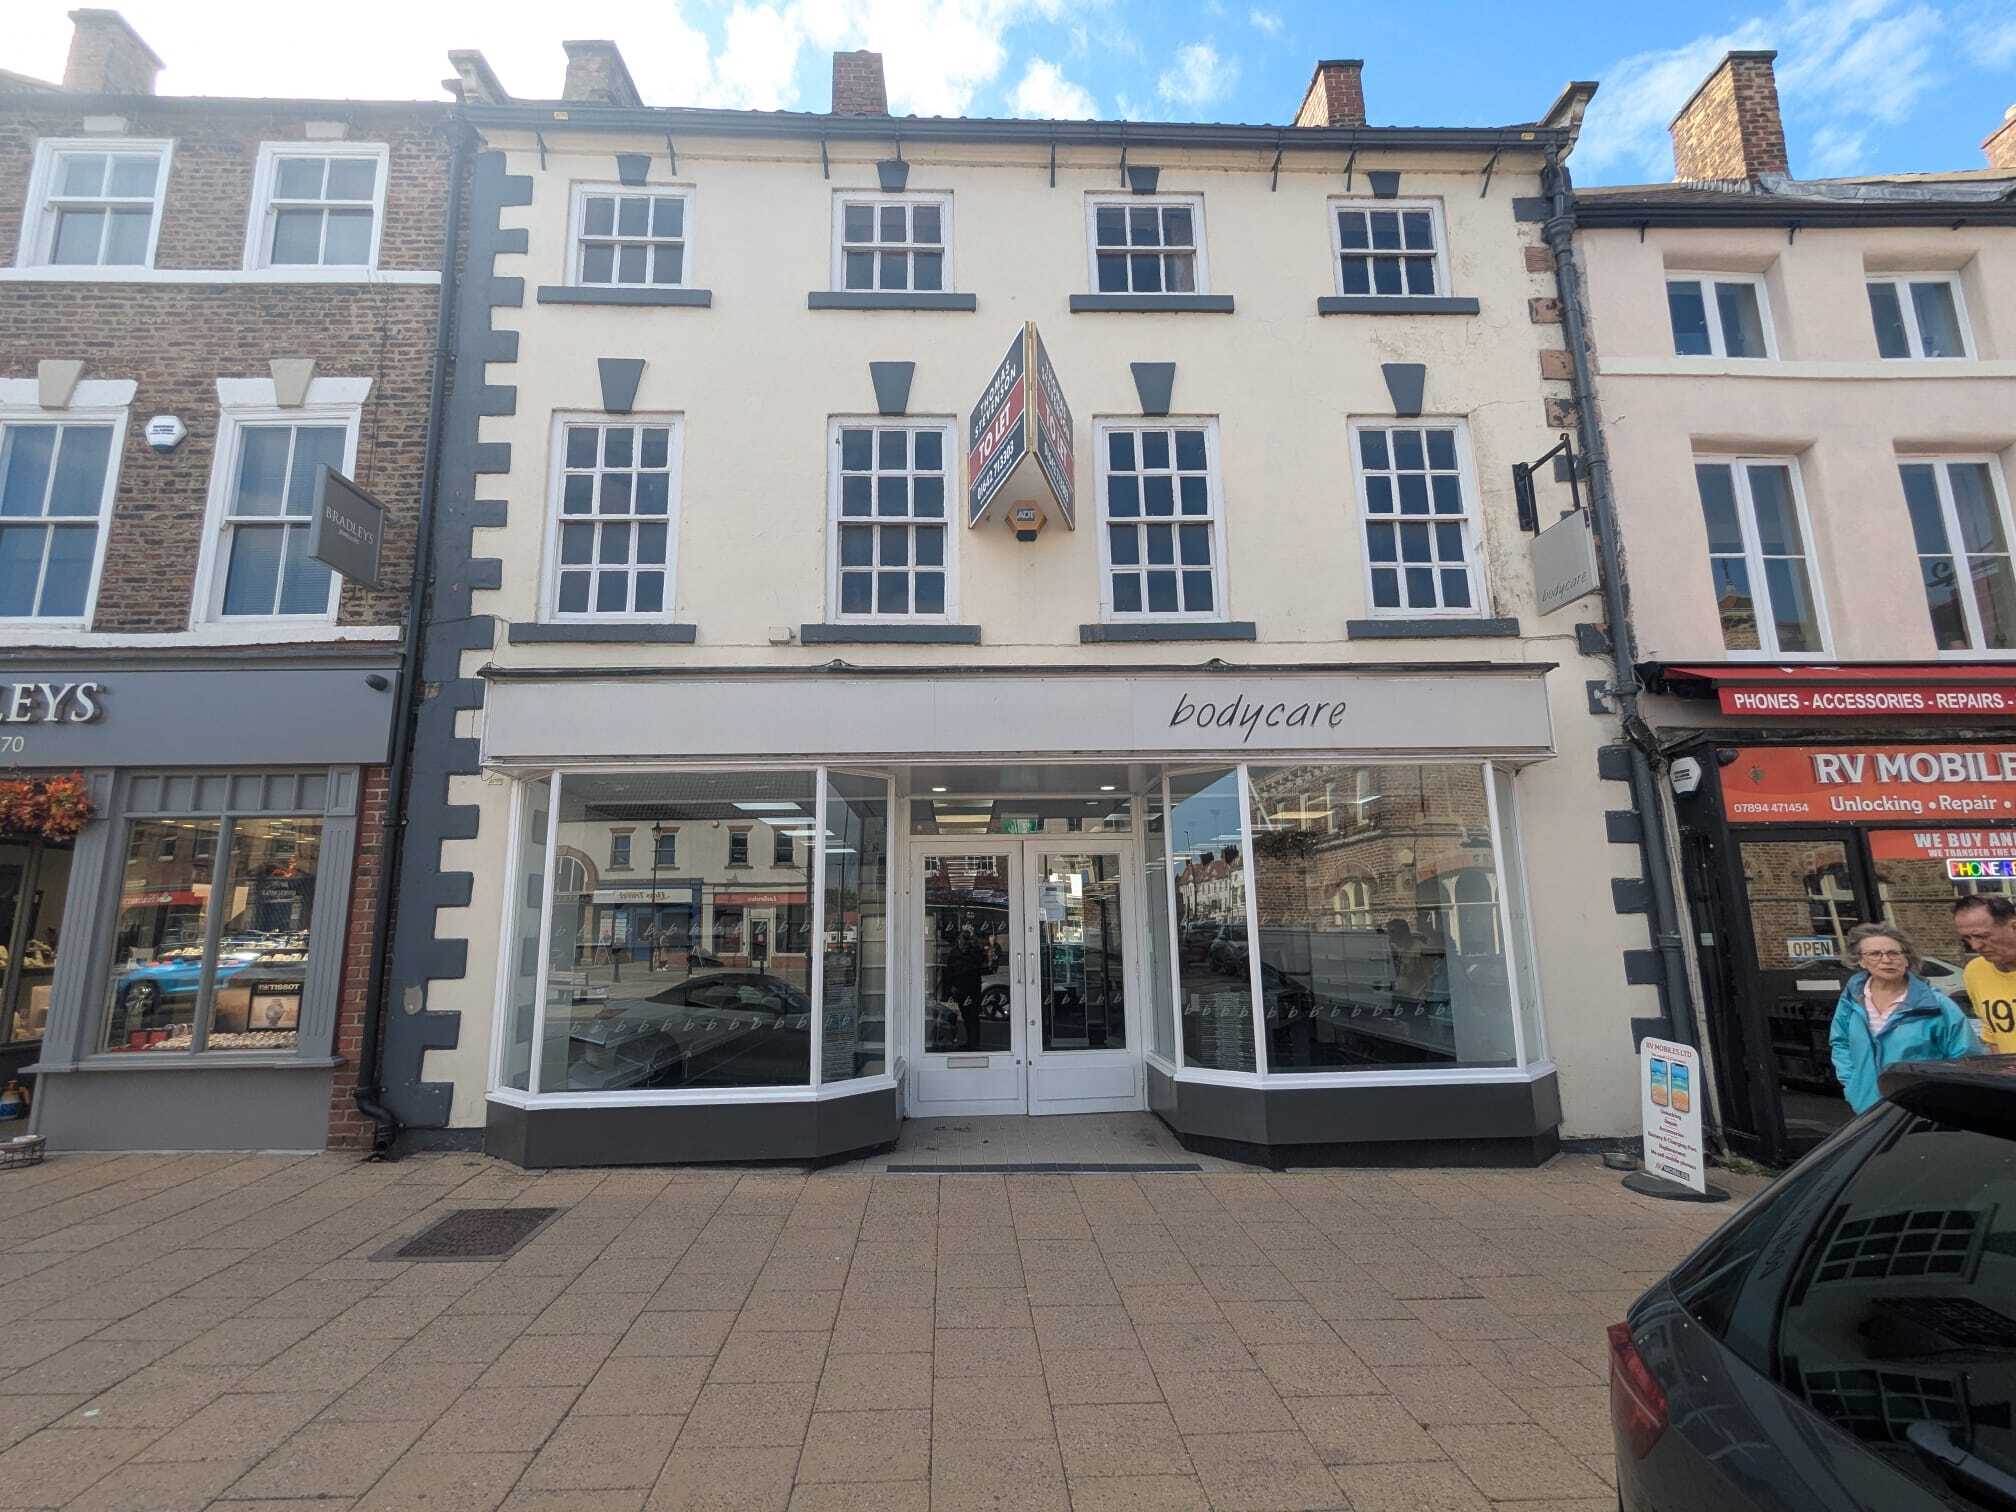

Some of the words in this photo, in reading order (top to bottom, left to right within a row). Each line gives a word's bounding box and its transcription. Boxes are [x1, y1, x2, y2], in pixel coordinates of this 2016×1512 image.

[974, 364, 1017, 438] STEVENSON
[980, 359, 1011, 414] THOMAS
[979, 432, 993, 465] TO
[995, 402, 1011, 442] LET
[1045, 404, 1057, 441] TO
[1057, 432, 1067, 466] LET
[326, 506, 375, 545] BRADLEYS
[1542, 571, 1586, 602] bodycare
[0, 682, 98, 722] EYS
[1734, 693, 1800, 709] PHONES
[1813, 693, 1924, 709] ACCESSORIES
[1936, 693, 2005, 708] REPAIRS
[1169, 693, 1346, 743] bodycare
[1814, 753, 1867, 784] RV
[1830, 795, 1923, 815] Unlocking
[1939, 795, 1998, 813] Repair
[1914, 833, 1943, 848] WE
[1947, 833, 1982, 847] BUY
[1951, 862, 2001, 876] PHONE
[1793, 942, 1830, 957] OPEN
[269, 983, 300, 991] TISSOT
[1982, 998, 2016, 1033] 19
